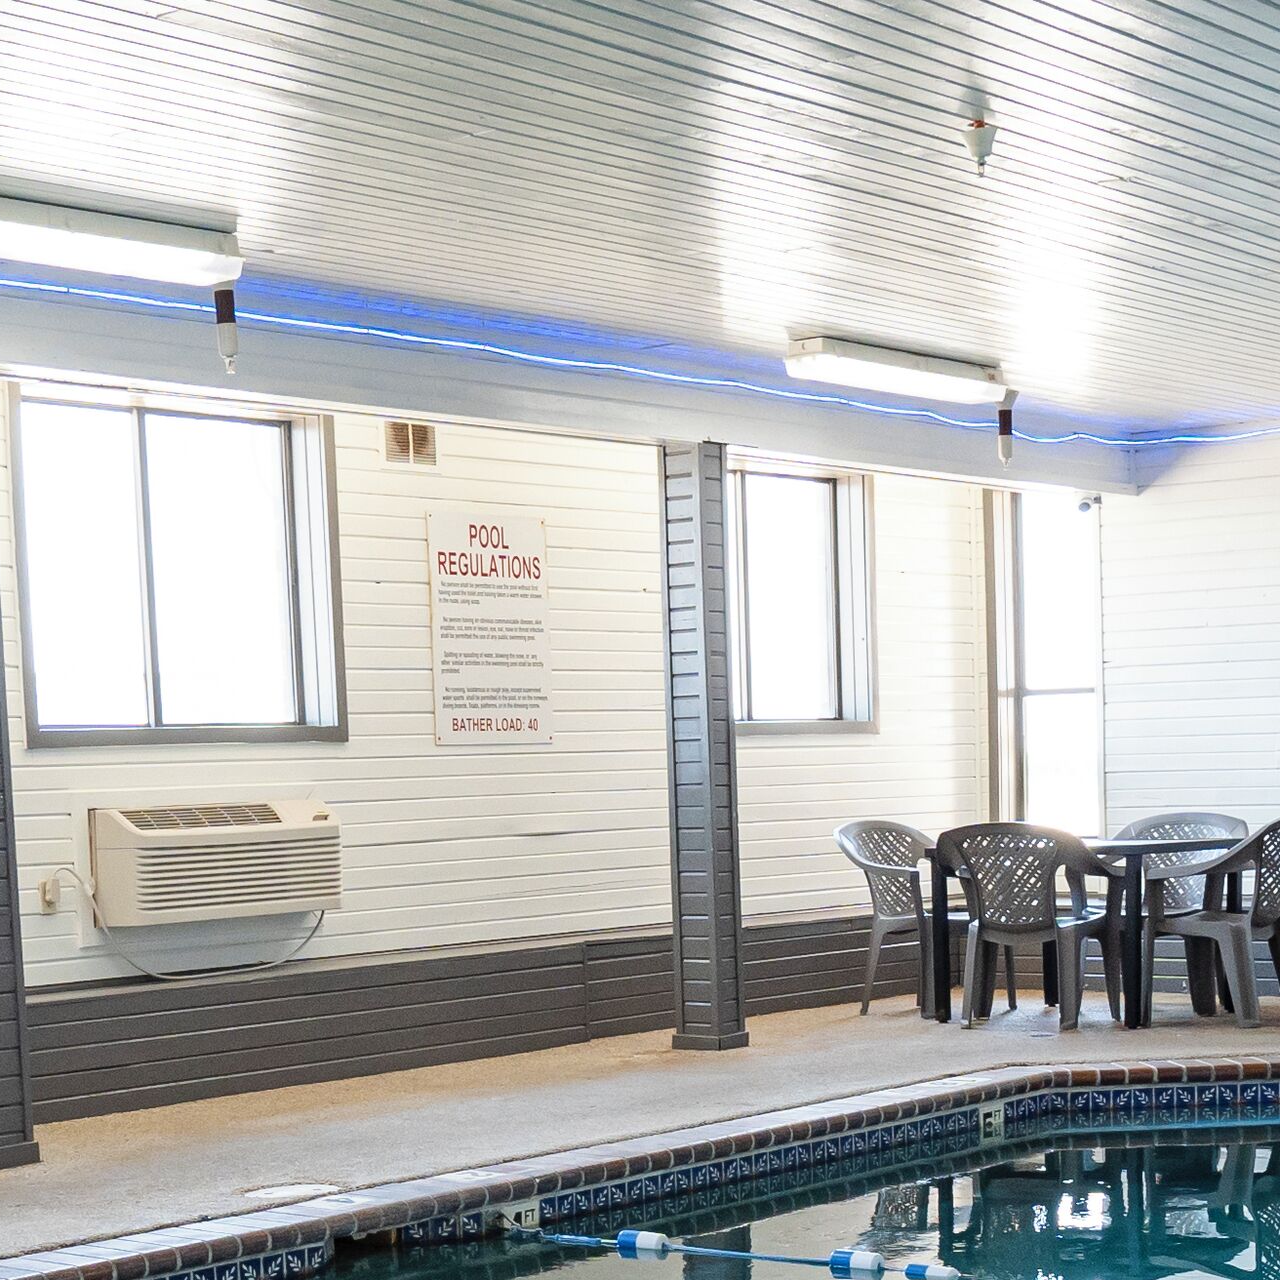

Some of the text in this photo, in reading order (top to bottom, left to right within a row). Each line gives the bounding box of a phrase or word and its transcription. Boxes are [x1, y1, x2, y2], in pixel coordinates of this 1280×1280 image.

[469, 524, 509, 550] POOL
[437, 551, 541, 580] REGULATIONS
[452, 718, 538, 732] BATHER LOAD: 40
[524, 1209, 536, 1223] FT
